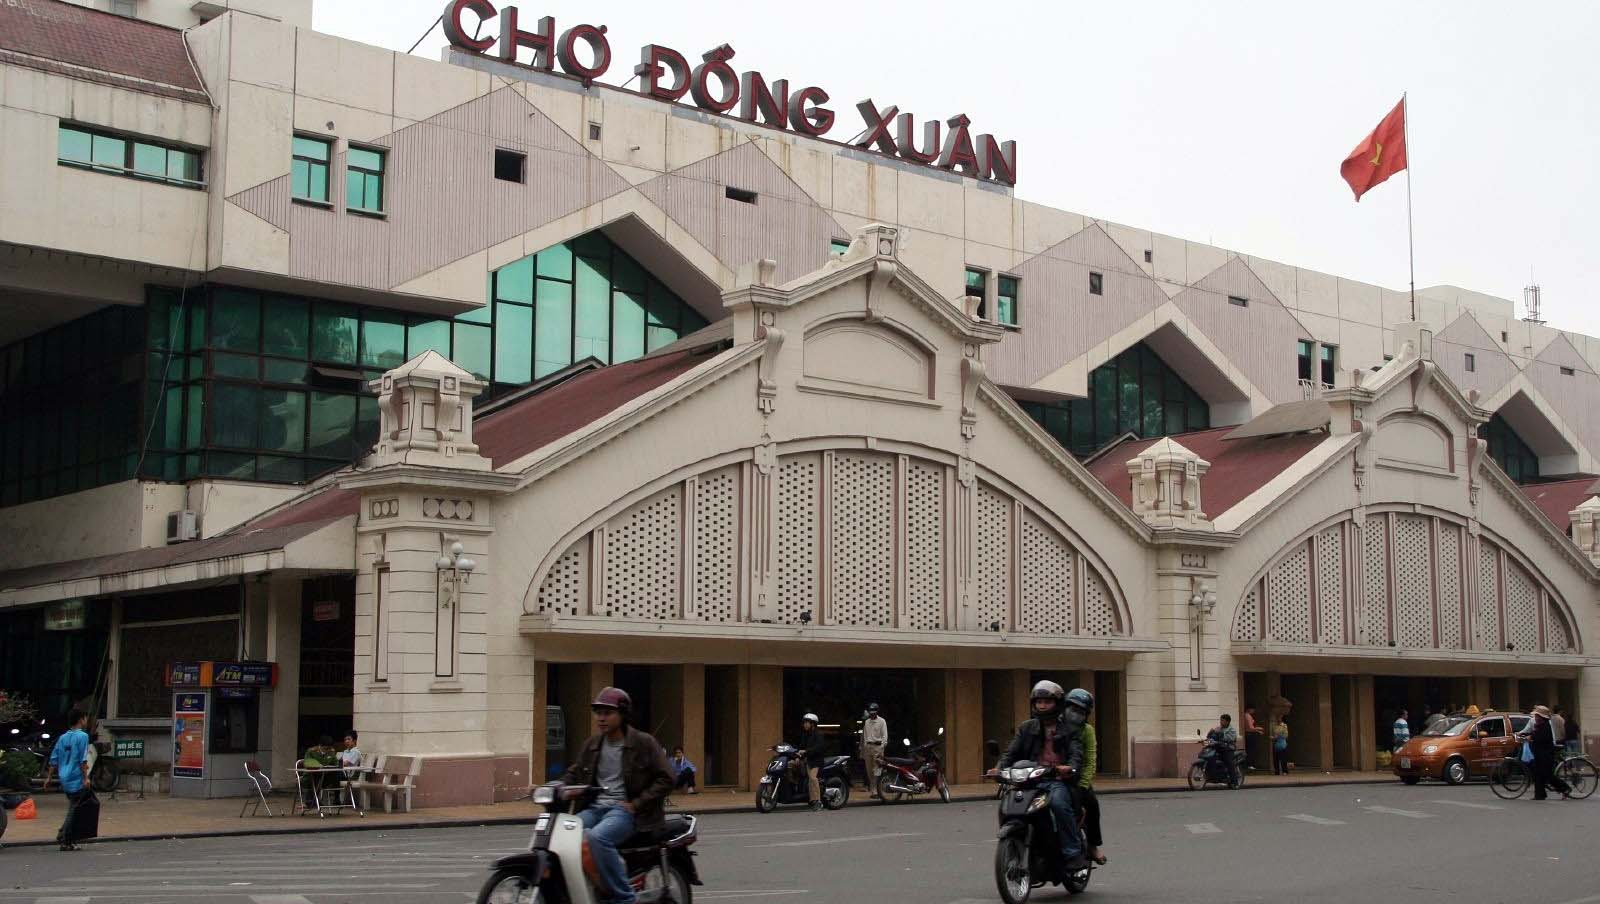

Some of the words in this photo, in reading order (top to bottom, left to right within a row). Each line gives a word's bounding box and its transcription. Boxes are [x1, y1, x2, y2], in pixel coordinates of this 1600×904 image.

[443, 0, 612, 91] CHỢ
[855, 98, 1017, 184] XUÂN
[215, 666, 241, 681] ATM
